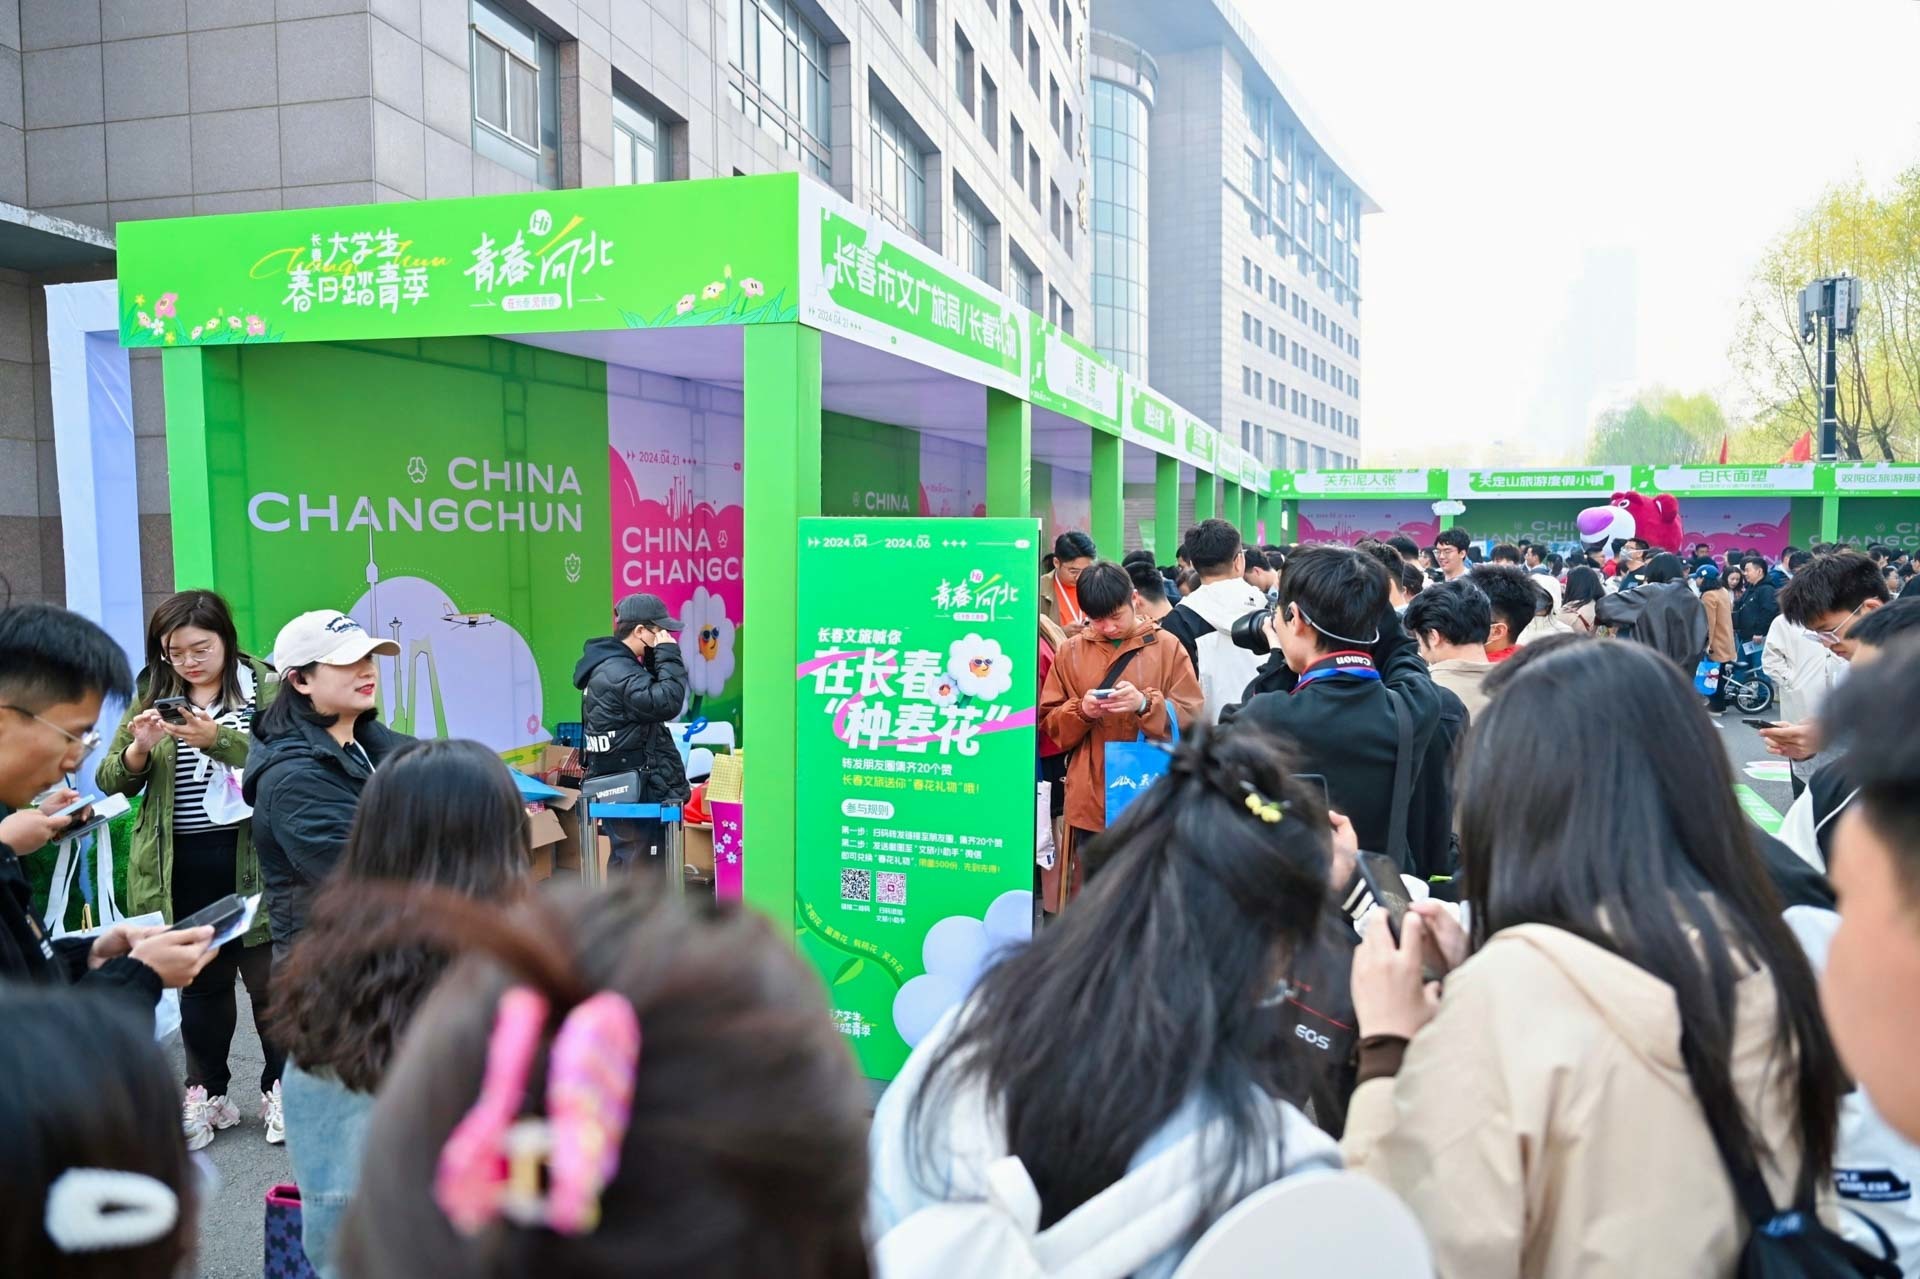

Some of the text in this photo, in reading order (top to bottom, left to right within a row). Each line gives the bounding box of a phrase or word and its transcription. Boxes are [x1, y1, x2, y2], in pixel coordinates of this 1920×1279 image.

[533, 214, 550, 232] Hi
[325, 227, 402, 265] 大学生
[282, 263, 430, 314] 春日踏青季
[639, 451, 680, 466] 2024.04.21
[448, 457, 583, 495] CHINA
[1325, 474, 1397, 487] 关东泥人张
[1699, 470, 1768, 483] 白氏面塑
[1841, 473, 1920, 484] 双阳区旅游服
[247, 492, 583, 533] CHANGCHUN
[865, 492, 910, 513] CHINA
[622, 526, 712, 553] CHINA
[823, 537, 931, 549] 2024.04 2024.06
[622, 557, 744, 587] CHANGC
[1335, 655, 1371, 666] Canon
[810, 646, 942, 700] 在长春
[842, 757, 953, 776] 转发朋友圈集齐20个赞
[847, 801, 889, 816] 参与规则
[1294, 1023, 1331, 1050] EOS
